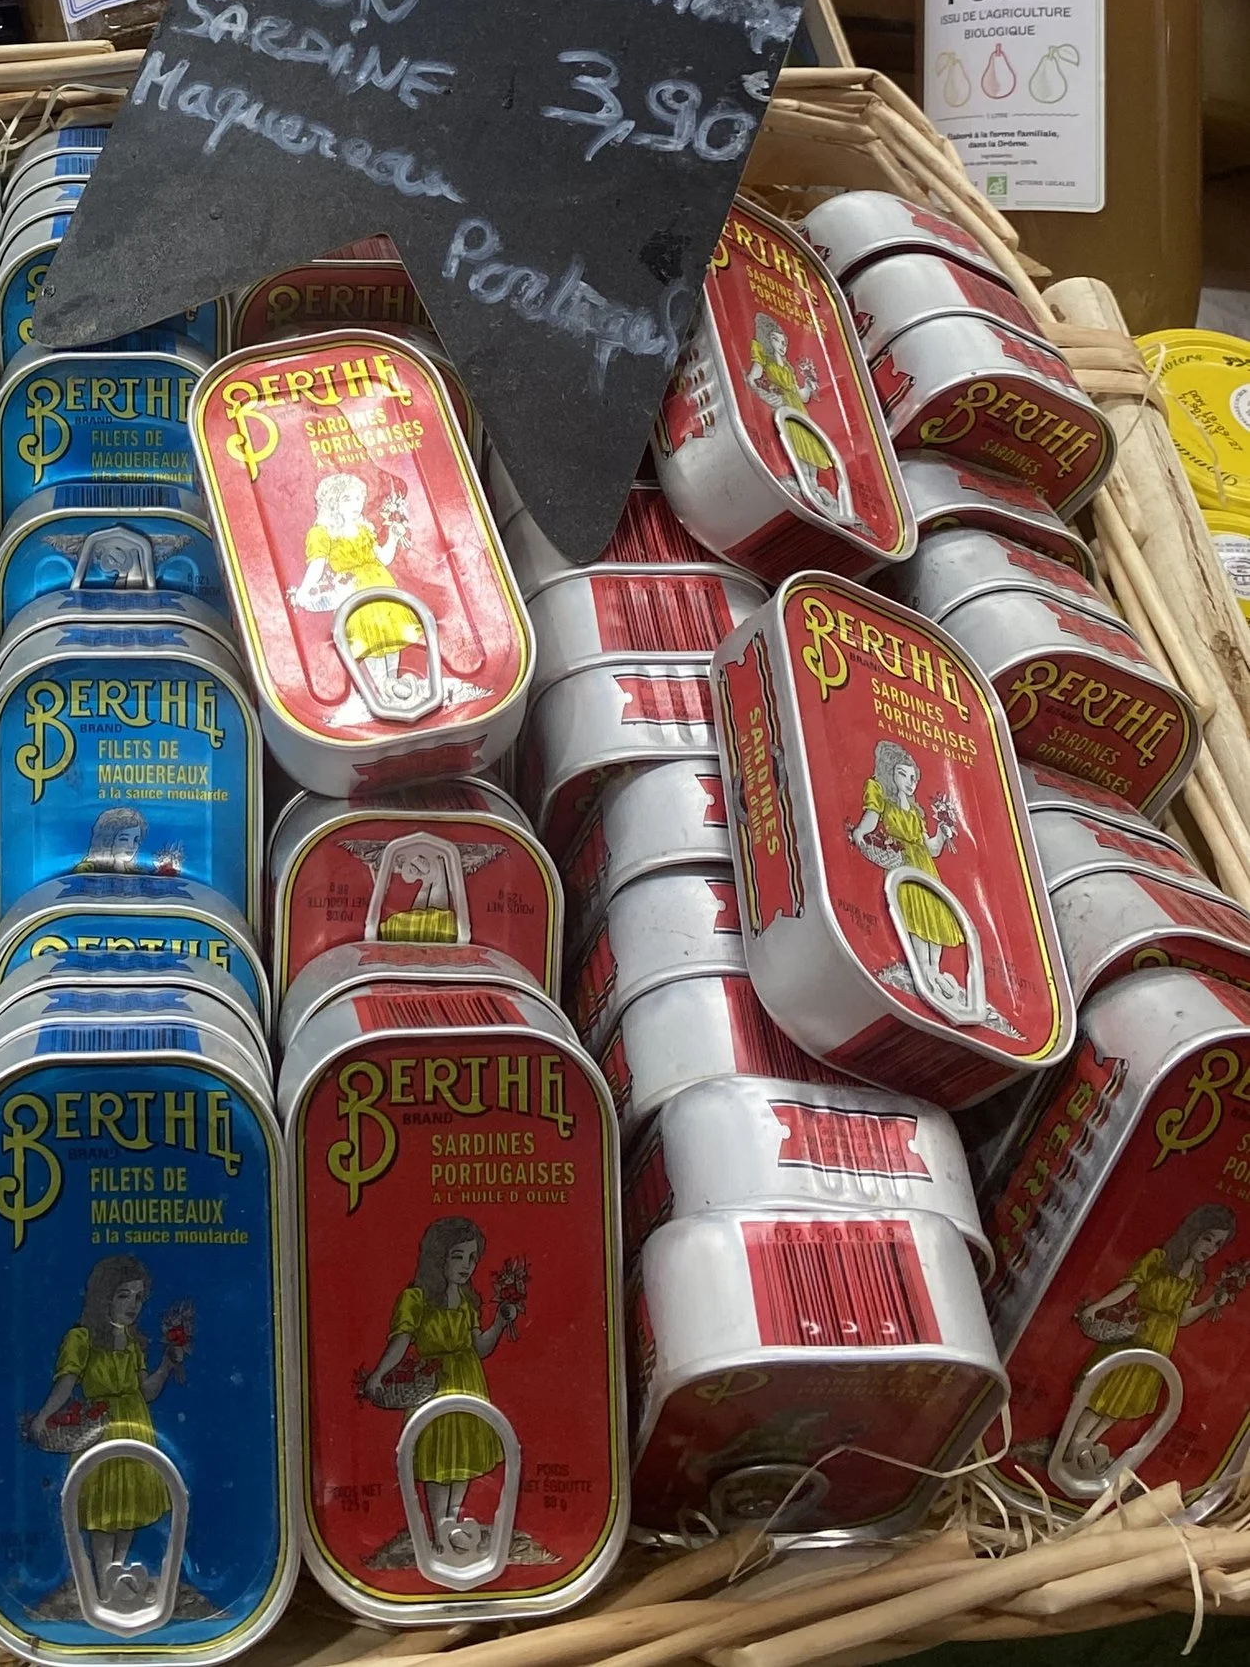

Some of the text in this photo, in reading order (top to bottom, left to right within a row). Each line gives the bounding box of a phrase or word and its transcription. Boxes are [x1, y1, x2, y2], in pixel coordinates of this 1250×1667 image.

[940, 14, 961, 26] ISSU
[962, 11, 977, 22] DE
[964, 25, 1037, 40] BIOLOGIQUE
[745, 264, 802, 306] SARDINES
[220, 352, 414, 482] BERTHE
[304, 407, 388, 438] SARDINES
[920, 379, 1097, 479] BERTHE
[91, 429, 164, 447] FILETS DE
[309, 419, 425, 458] PORTUGAISES
[91, 450, 191, 470] MAQUEREAUX
[799, 595, 970, 724] BERTHE
[870, 677, 946, 725] SARDINES
[1004, 659, 1178, 769] BERTHE
[79, 723, 123, 734] BRAND
[873, 698, 979, 757] PORTUGAISES
[14, 678, 226, 806] BERTHE
[97, 739, 179, 760] FILETS DE
[1047, 725, 1122, 765] SARDINES
[97, 766, 209, 785] MAQUEREAUX
[748, 706, 781, 857] SARDINES
[1035, 742, 1134, 797] PORTUGAISES
[108, 787, 229, 802] la sauce moutarde
[401, 1112, 454, 1126] BRAND
[327, 1054, 577, 1215] BERTHE
[430, 1132, 535, 1157] SARDINES
[89, 1167, 187, 1192] FILETS DE
[430, 1162, 577, 1186] PORTUGAISES
[90, 1199, 224, 1225] MAQUEREAUX
[105, 1228, 249, 1245] la sauce moutarde
